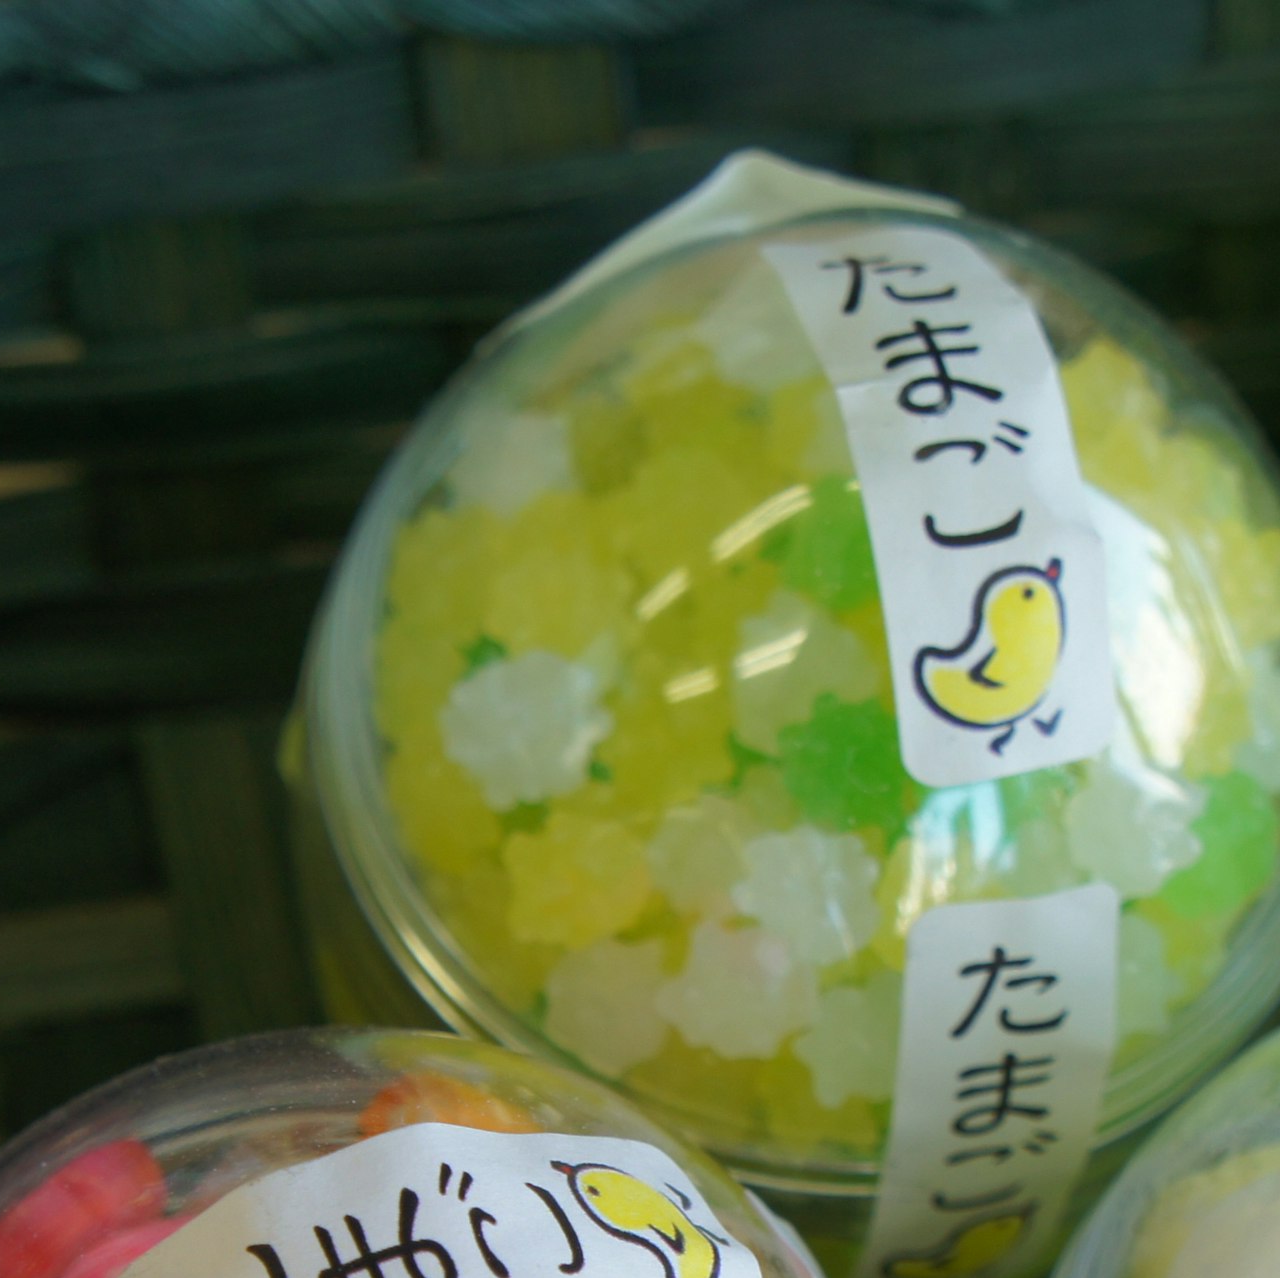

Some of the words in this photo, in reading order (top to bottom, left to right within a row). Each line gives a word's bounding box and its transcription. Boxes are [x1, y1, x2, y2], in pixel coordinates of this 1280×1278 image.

[820, 256, 1030, 549] たまご
[930, 946, 1069, 1210] たまご
